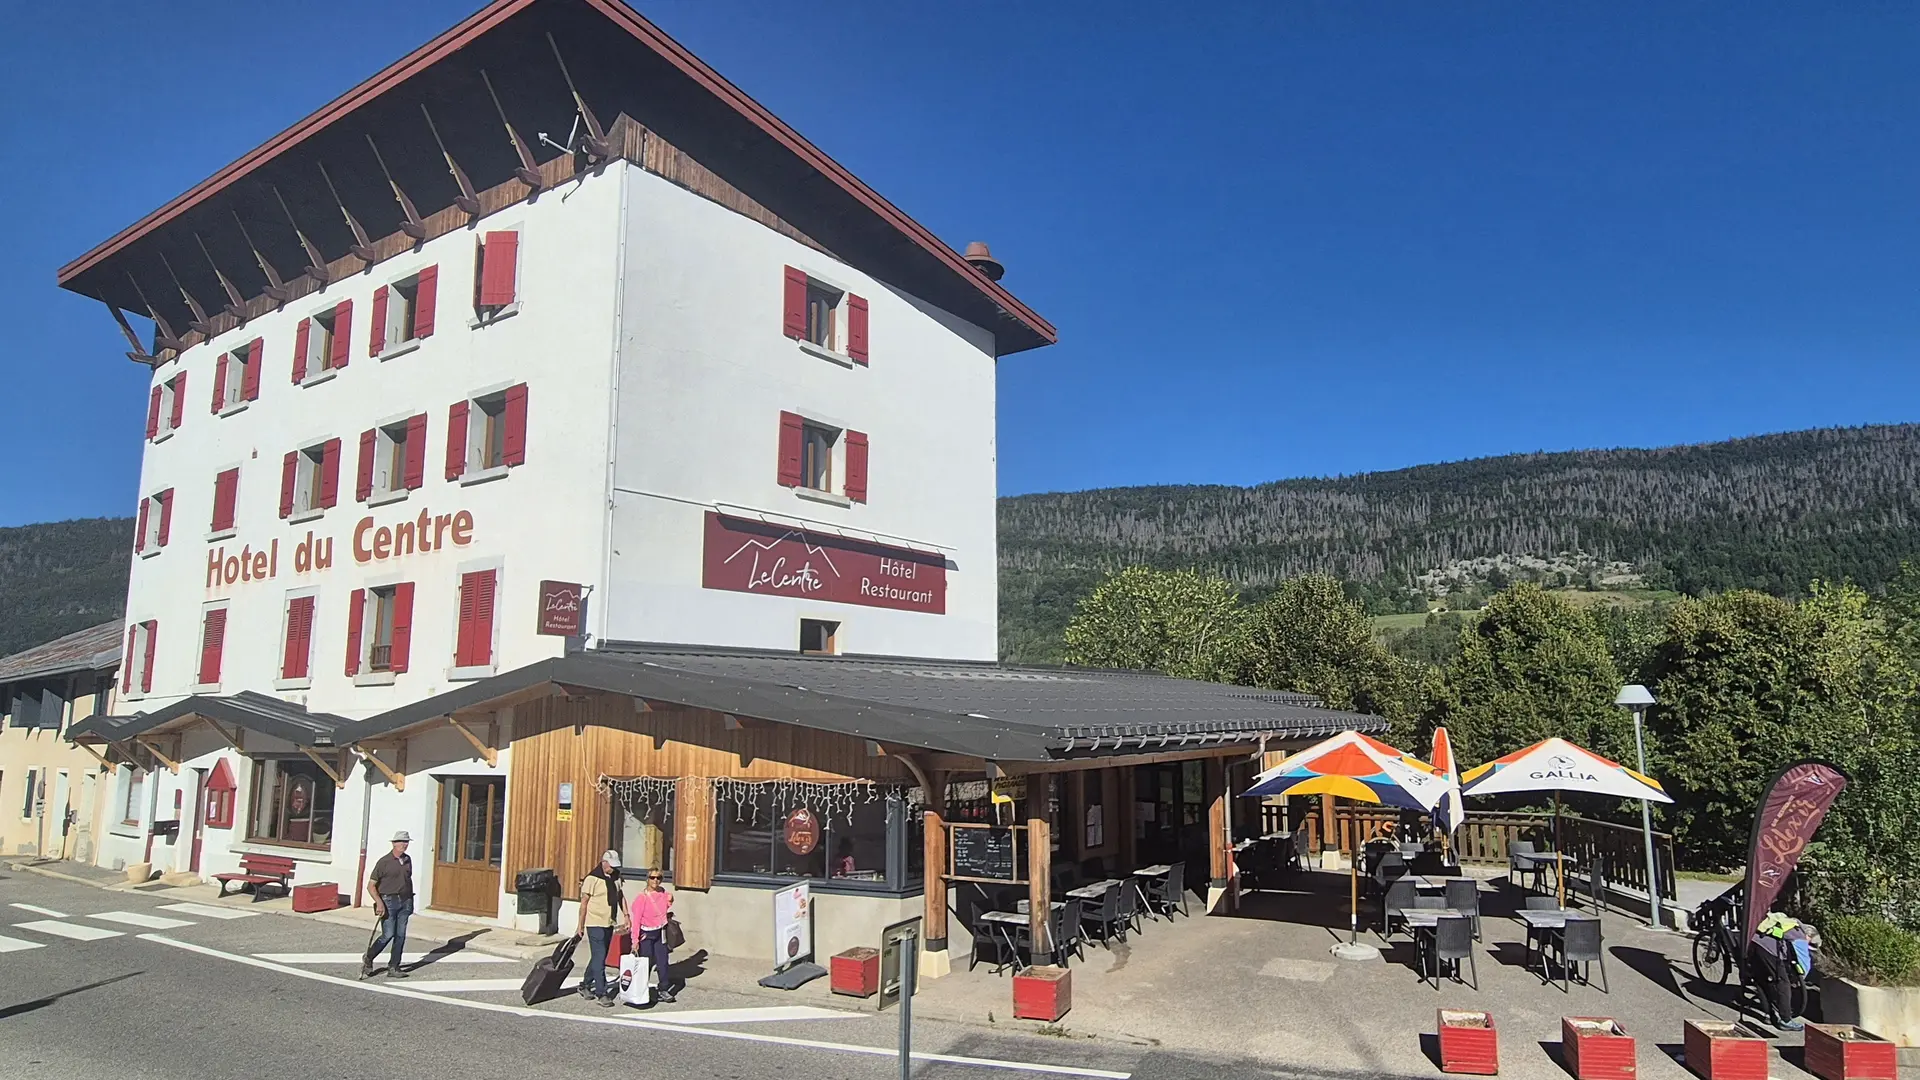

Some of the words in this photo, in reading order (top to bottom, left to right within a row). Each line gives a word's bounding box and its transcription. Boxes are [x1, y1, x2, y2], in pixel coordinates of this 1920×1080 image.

[205, 538, 279, 588] Hotel
[295, 531, 333, 573] du
[352, 507, 474, 563] Centre
[880, 557, 916, 579] Hôtel
[861, 577, 933, 604] Restaurant
[545, 620, 577, 630] Restaurant
[553, 614, 570, 623] Hôtel
[1529, 770, 1599, 782] GALLIA
